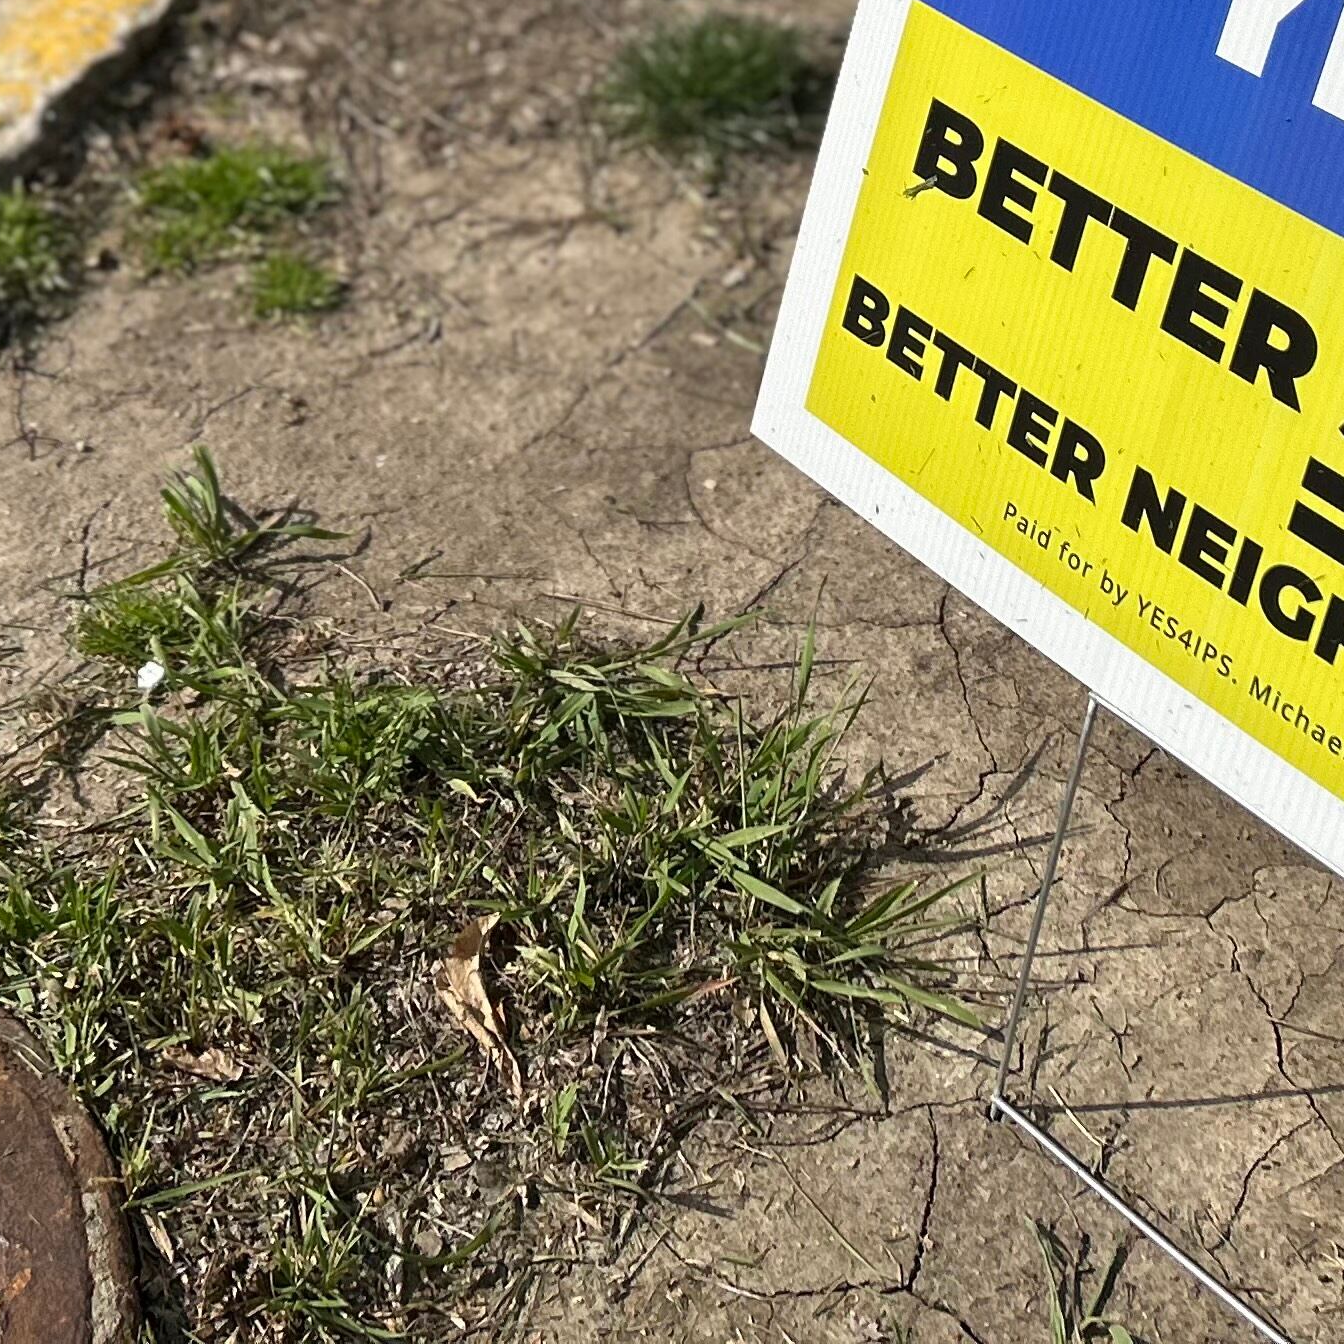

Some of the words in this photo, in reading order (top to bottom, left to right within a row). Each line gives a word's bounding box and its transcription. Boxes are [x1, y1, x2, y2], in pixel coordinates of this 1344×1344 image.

[912, 97, 1318, 413] BETTER
[842, 274, 1106, 505] BETTER
[1003, 502, 1052, 550] Paid
[1056, 541, 1093, 578] for
[1100, 570, 1129, 605] by
[1137, 594, 1237, 684] YES4IPS.
